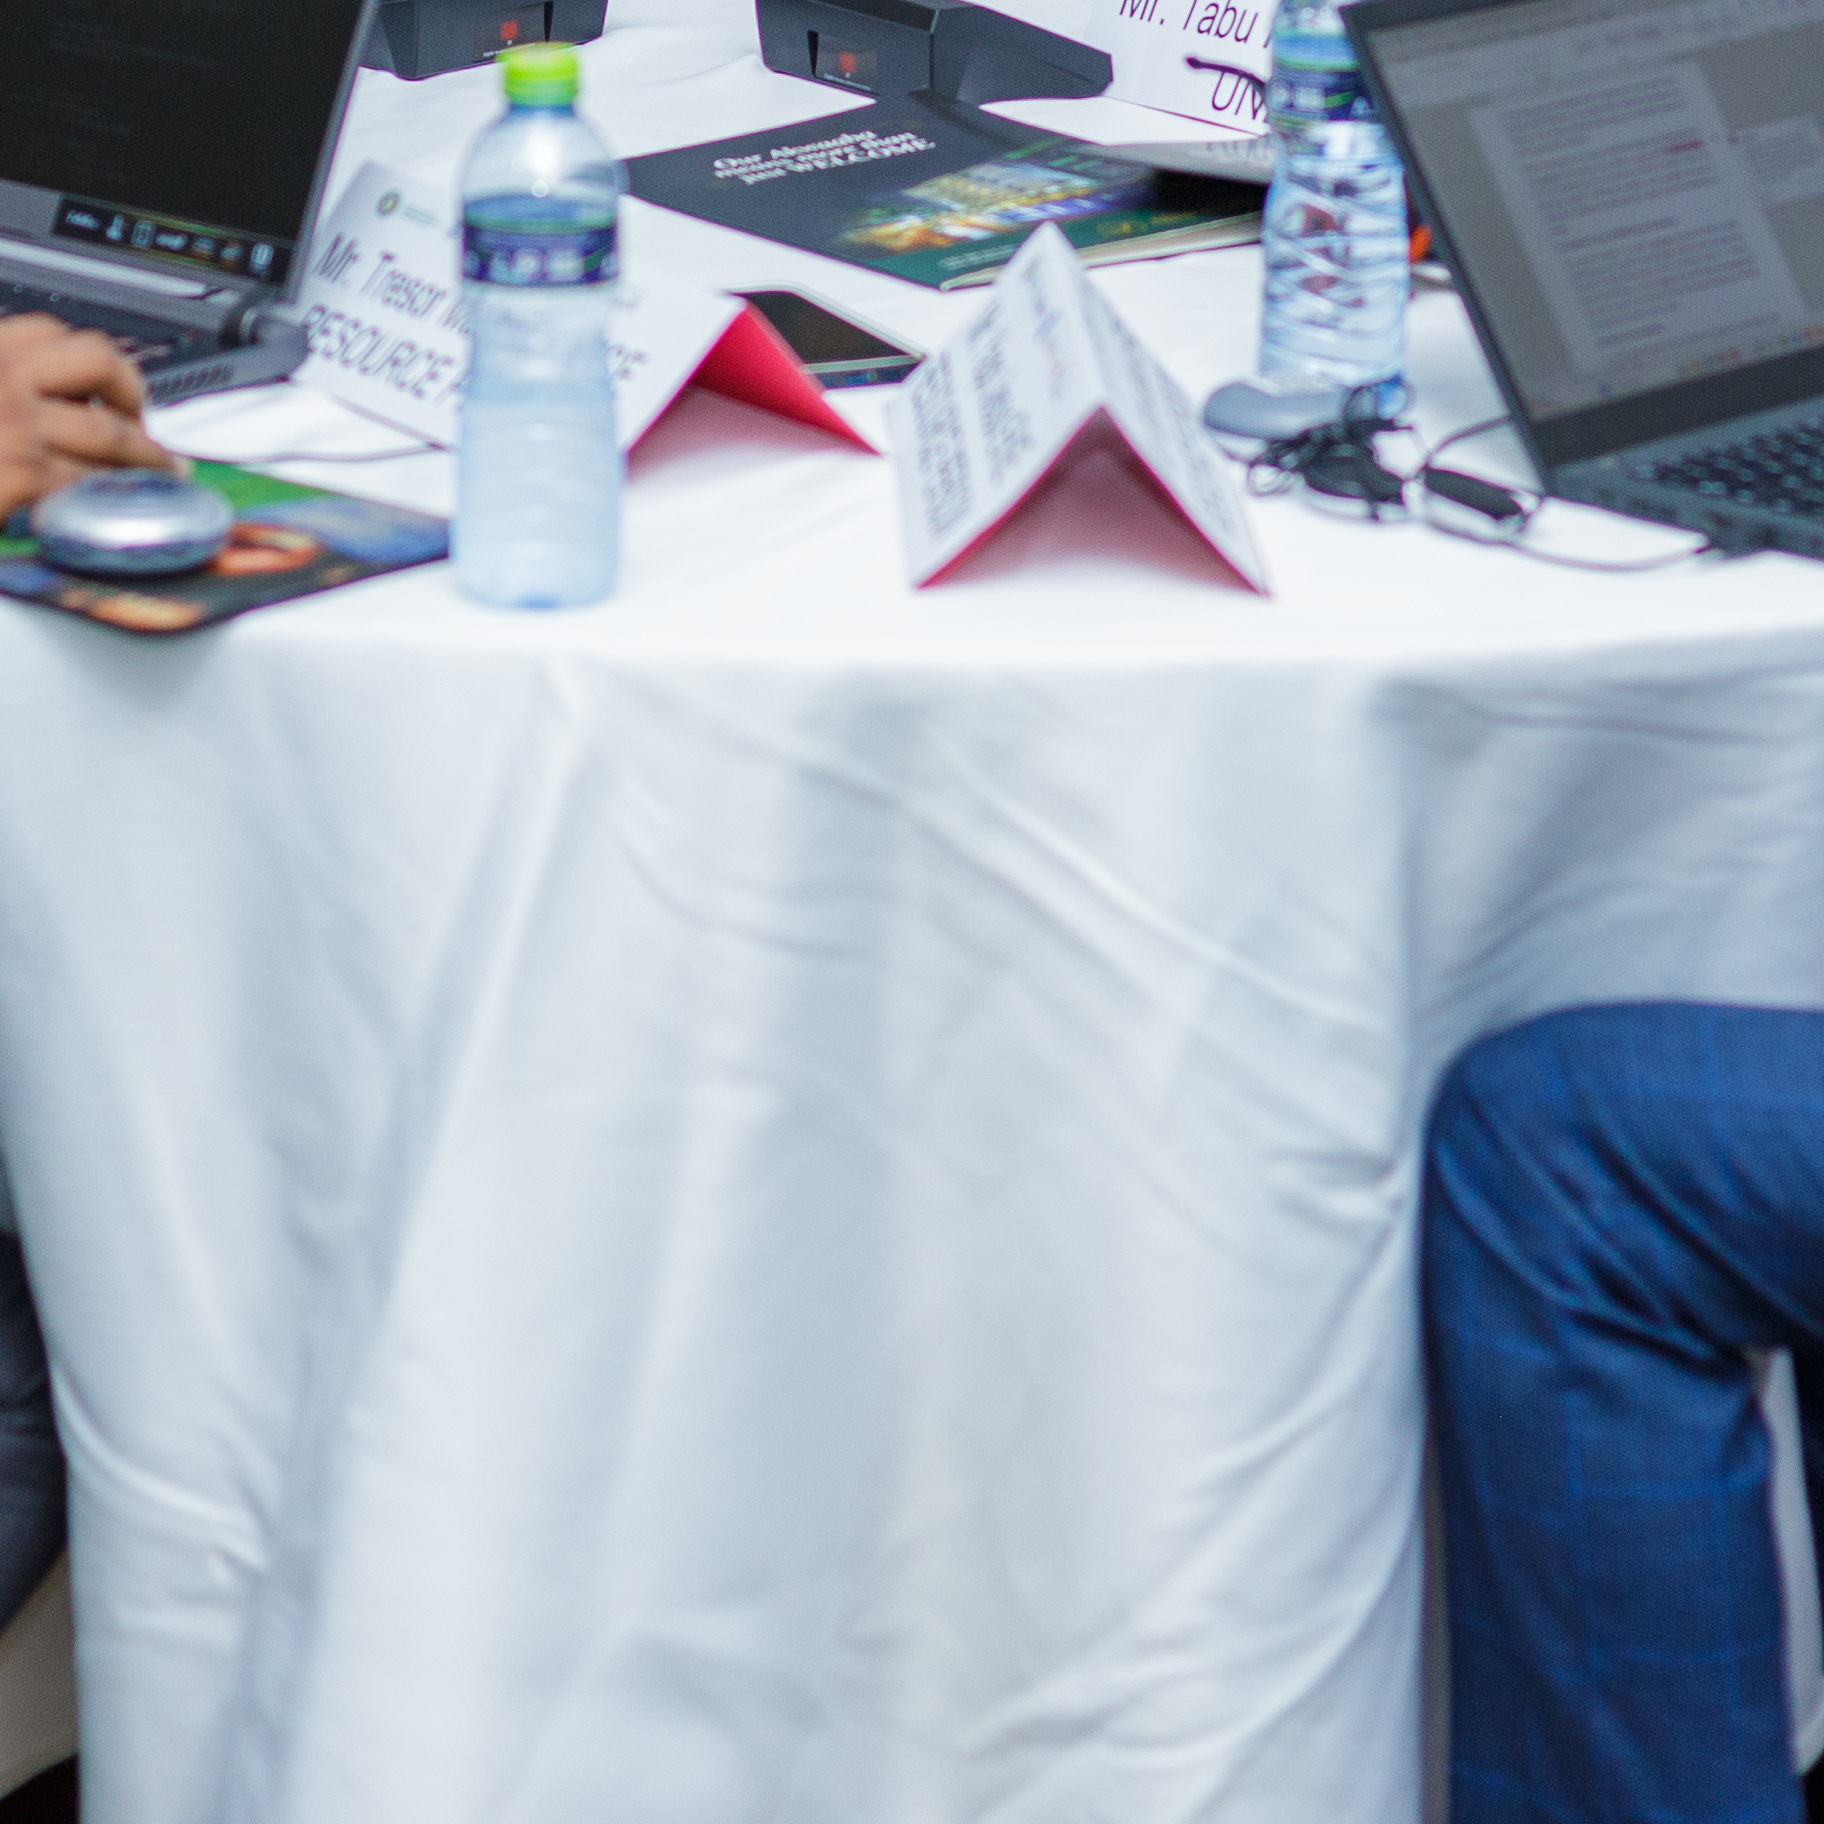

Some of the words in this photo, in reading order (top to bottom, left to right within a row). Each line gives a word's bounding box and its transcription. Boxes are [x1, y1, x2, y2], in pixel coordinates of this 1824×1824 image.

[1211, 72, 1268, 124] UN
[312, 232, 361, 289] Mr.
[358, 251, 448, 317] Tresor
